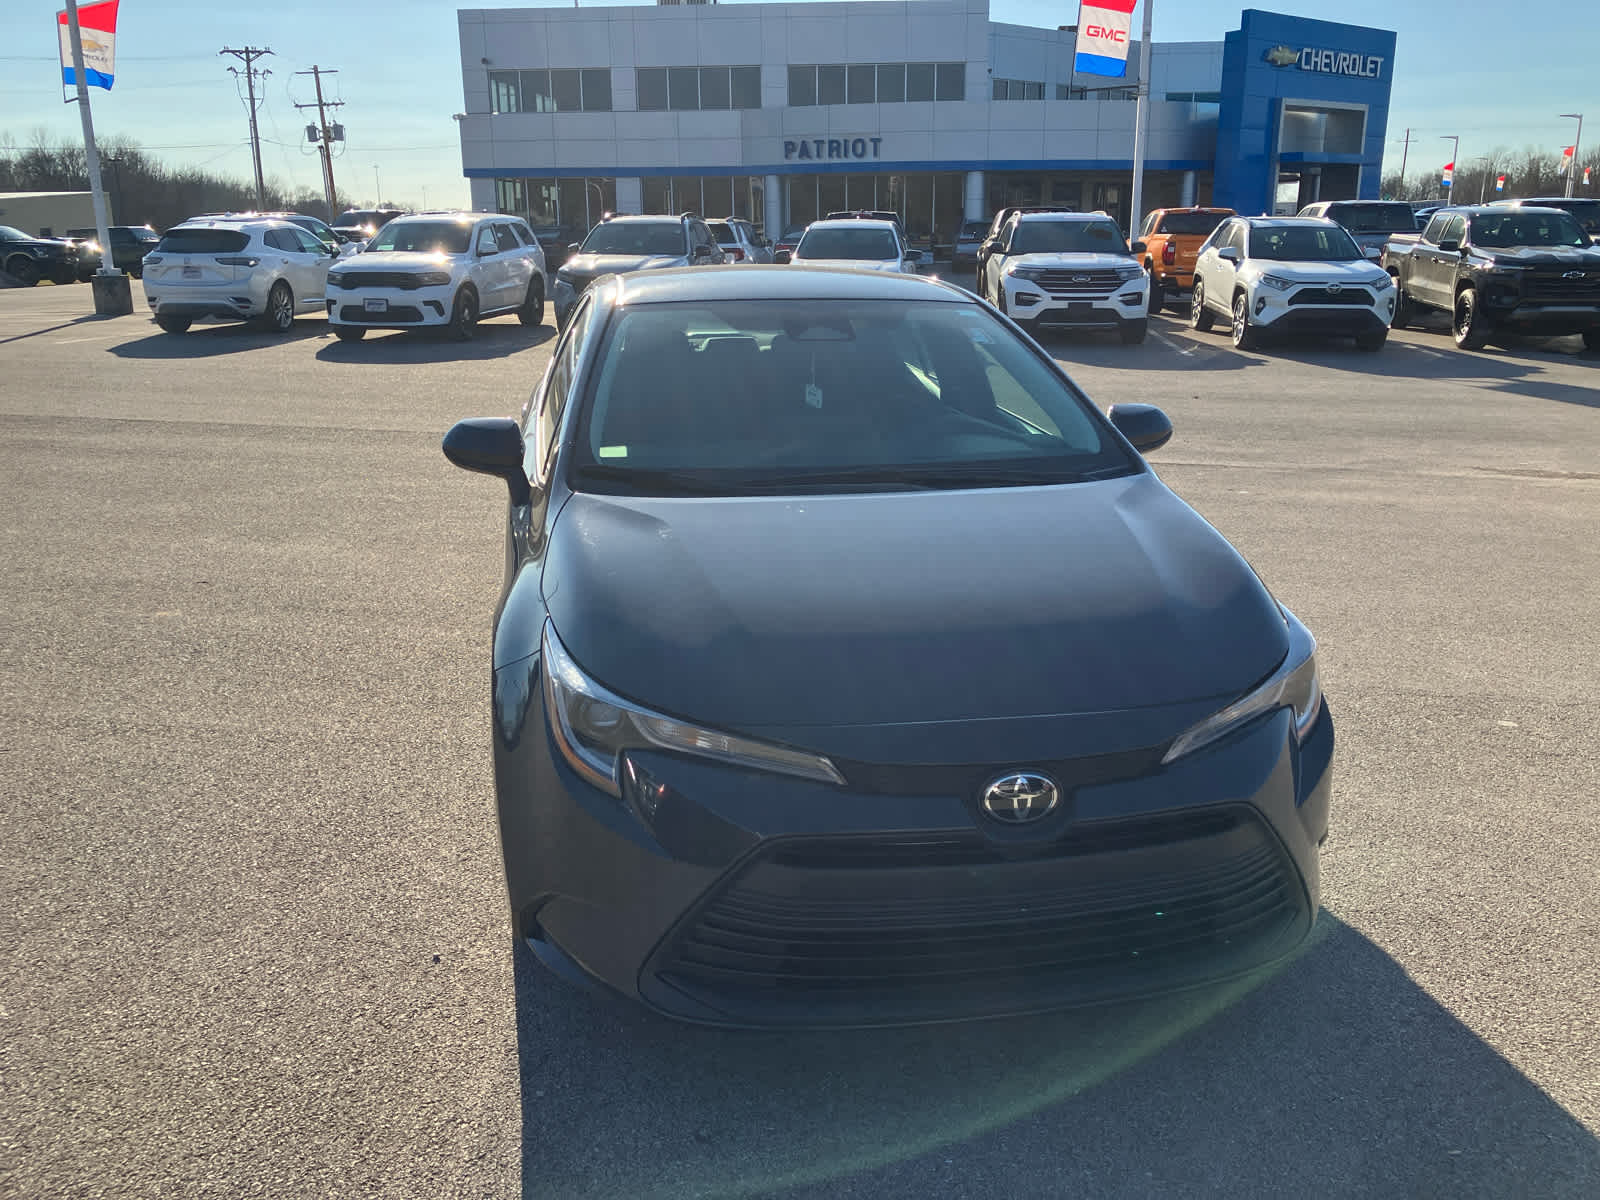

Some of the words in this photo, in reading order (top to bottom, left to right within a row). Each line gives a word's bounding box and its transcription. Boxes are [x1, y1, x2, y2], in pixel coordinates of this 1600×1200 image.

[1086, 24, 1126, 43] GMC
[1301, 47, 1384, 78] CHEVROLET
[783, 137, 882, 160] PATRIOT
